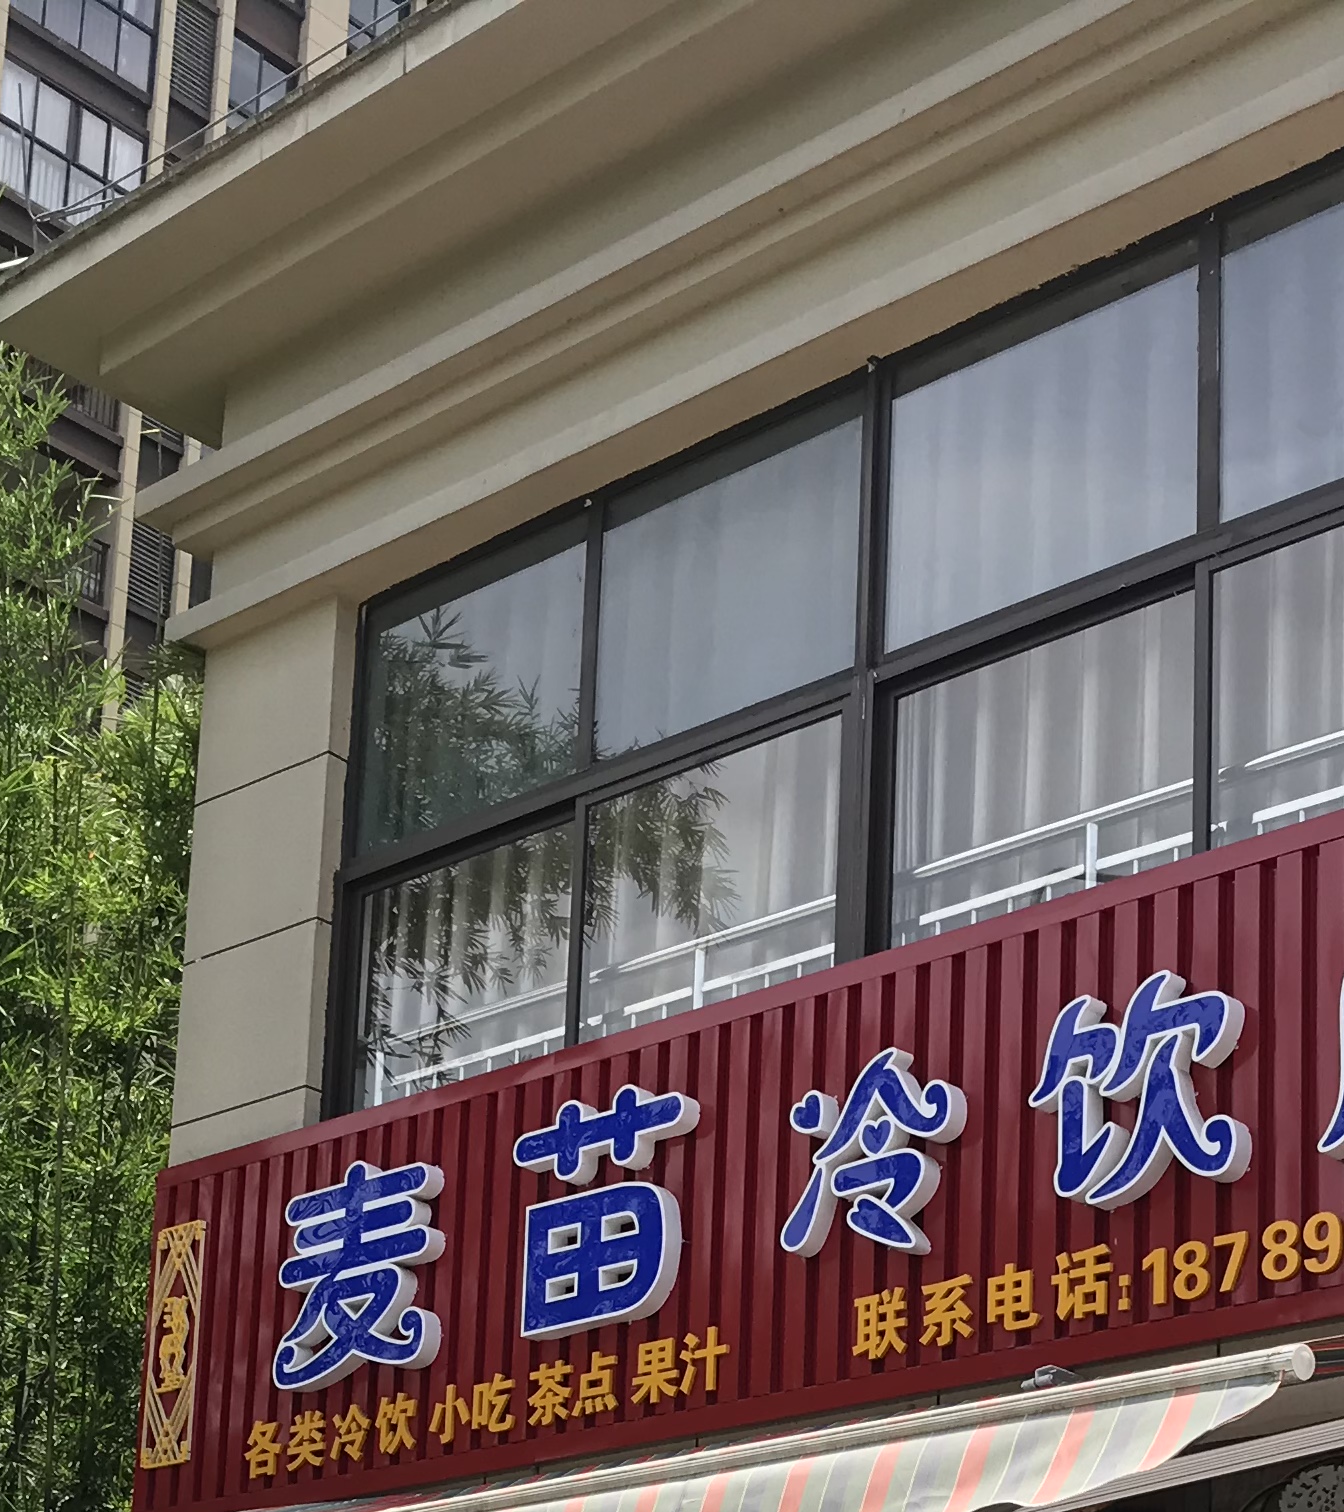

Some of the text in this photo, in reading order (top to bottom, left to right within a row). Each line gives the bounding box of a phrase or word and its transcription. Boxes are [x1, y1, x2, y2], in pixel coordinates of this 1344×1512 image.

[244, 1325, 730, 1478] 各类冷饮 小吃 茶点 果汁
